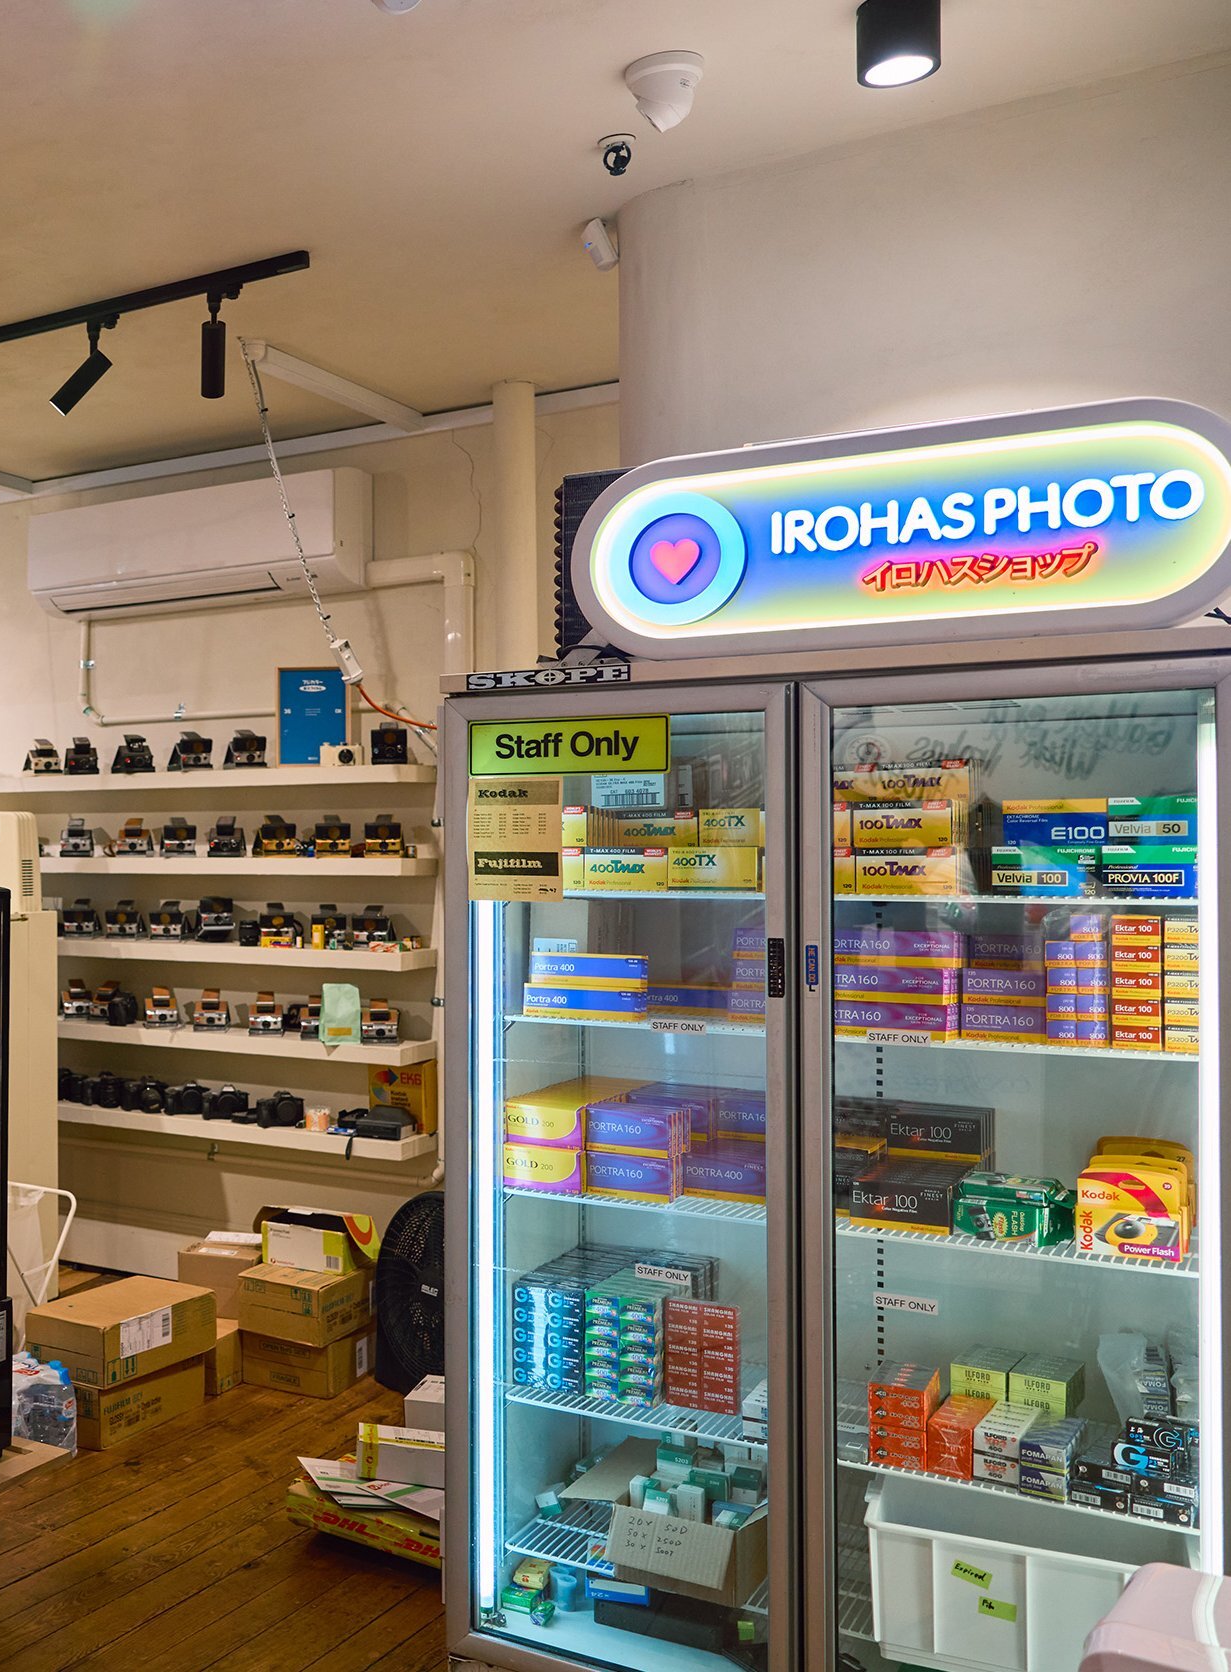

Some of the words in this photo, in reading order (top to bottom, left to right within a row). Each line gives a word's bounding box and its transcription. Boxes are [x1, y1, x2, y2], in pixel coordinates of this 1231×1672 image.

[771, 491, 974, 555] IROHAS
[983, 469, 1205, 535] PHOTO
[863, 541, 1100, 592] イロハスショップ
[468, 665, 629, 690] SKOPE
[495, 732, 563, 759] Staff
[570, 730, 639, 761] Only
[478, 789, 528, 798] Kodak
[703, 815, 745, 828] 400TX
[1051, 826, 1105, 840] E100
[1114, 823, 1151, 834] Velvia
[1162, 823, 1181, 834] 50
[477, 858, 543, 870] Fujifilm
[672, 854, 717, 867] 400TX
[996, 873, 1033, 883] Velvia
[1041, 873, 1061, 883] 100
[1108, 873, 1151, 883] PROVIA
[1152, 873, 1179, 883] 100F
[1082, 926, 1099, 934] 800
[1114, 924, 1136, 933] Ektar
[834, 940, 868, 949] ORTRA
[870, 940, 890, 950] 160
[1114, 951, 1136, 960] Ektar
[534, 961, 559, 972] Portra
[559, 963, 575, 972] 400
[967, 978, 1012, 990] PORTRA
[1014, 980, 1036, 991] 160
[526, 994, 551, 1004] Portra
[551, 995, 567, 1004] 400
[967, 996, 989, 1004] Kodak
[1114, 1004, 1136, 1013] Ektar
[652, 1021, 679, 1031] STAFF
[680, 1023, 704, 1032] ONLY
[965, 1014, 1011, 1026] PORTRA
[1012, 1016, 1034, 1027] 160
[868, 1032, 899, 1043] STAFF
[901, 1034, 929, 1044] ONLY
[507, 1114, 539, 1126] GOLD
[588, 1121, 624, 1133] PORTRA
[625, 1125, 641, 1135] 160
[890, 1122, 923, 1137] Ektar
[930, 1126, 952, 1140] 100
[506, 1157, 539, 1169] GOLD
[540, 1163, 553, 1171] 200
[1176, 1155, 1186, 1163] 27
[589, 1165, 625, 1177] PORTRA
[625, 1169, 643, 1179] 160
[686, 1166, 723, 1178] PORTRA
[724, 1170, 743, 1180] 400
[852, 1190, 889, 1206] Ektar
[894, 1194, 918, 1209] 100
[1081, 1189, 1120, 1201] Kodak
[1080, 1210, 1093, 1250] Kodak
[1123, 1244, 1150, 1256] Power
[1151, 1246, 1174, 1257] Flash
[637, 1265, 663, 1277] STAFF
[665, 1270, 689, 1282] ONLY
[875, 1296, 906, 1308] STAFF
[908, 1301, 936, 1313] ONLY
[965, 1369, 990, 1381] ILFORD
[1024, 1378, 1051, 1391] ILFORD
[1021, 1448, 1063, 1463] FOMAPAN
[1021, 1475, 1063, 1490] FOMAPAN
